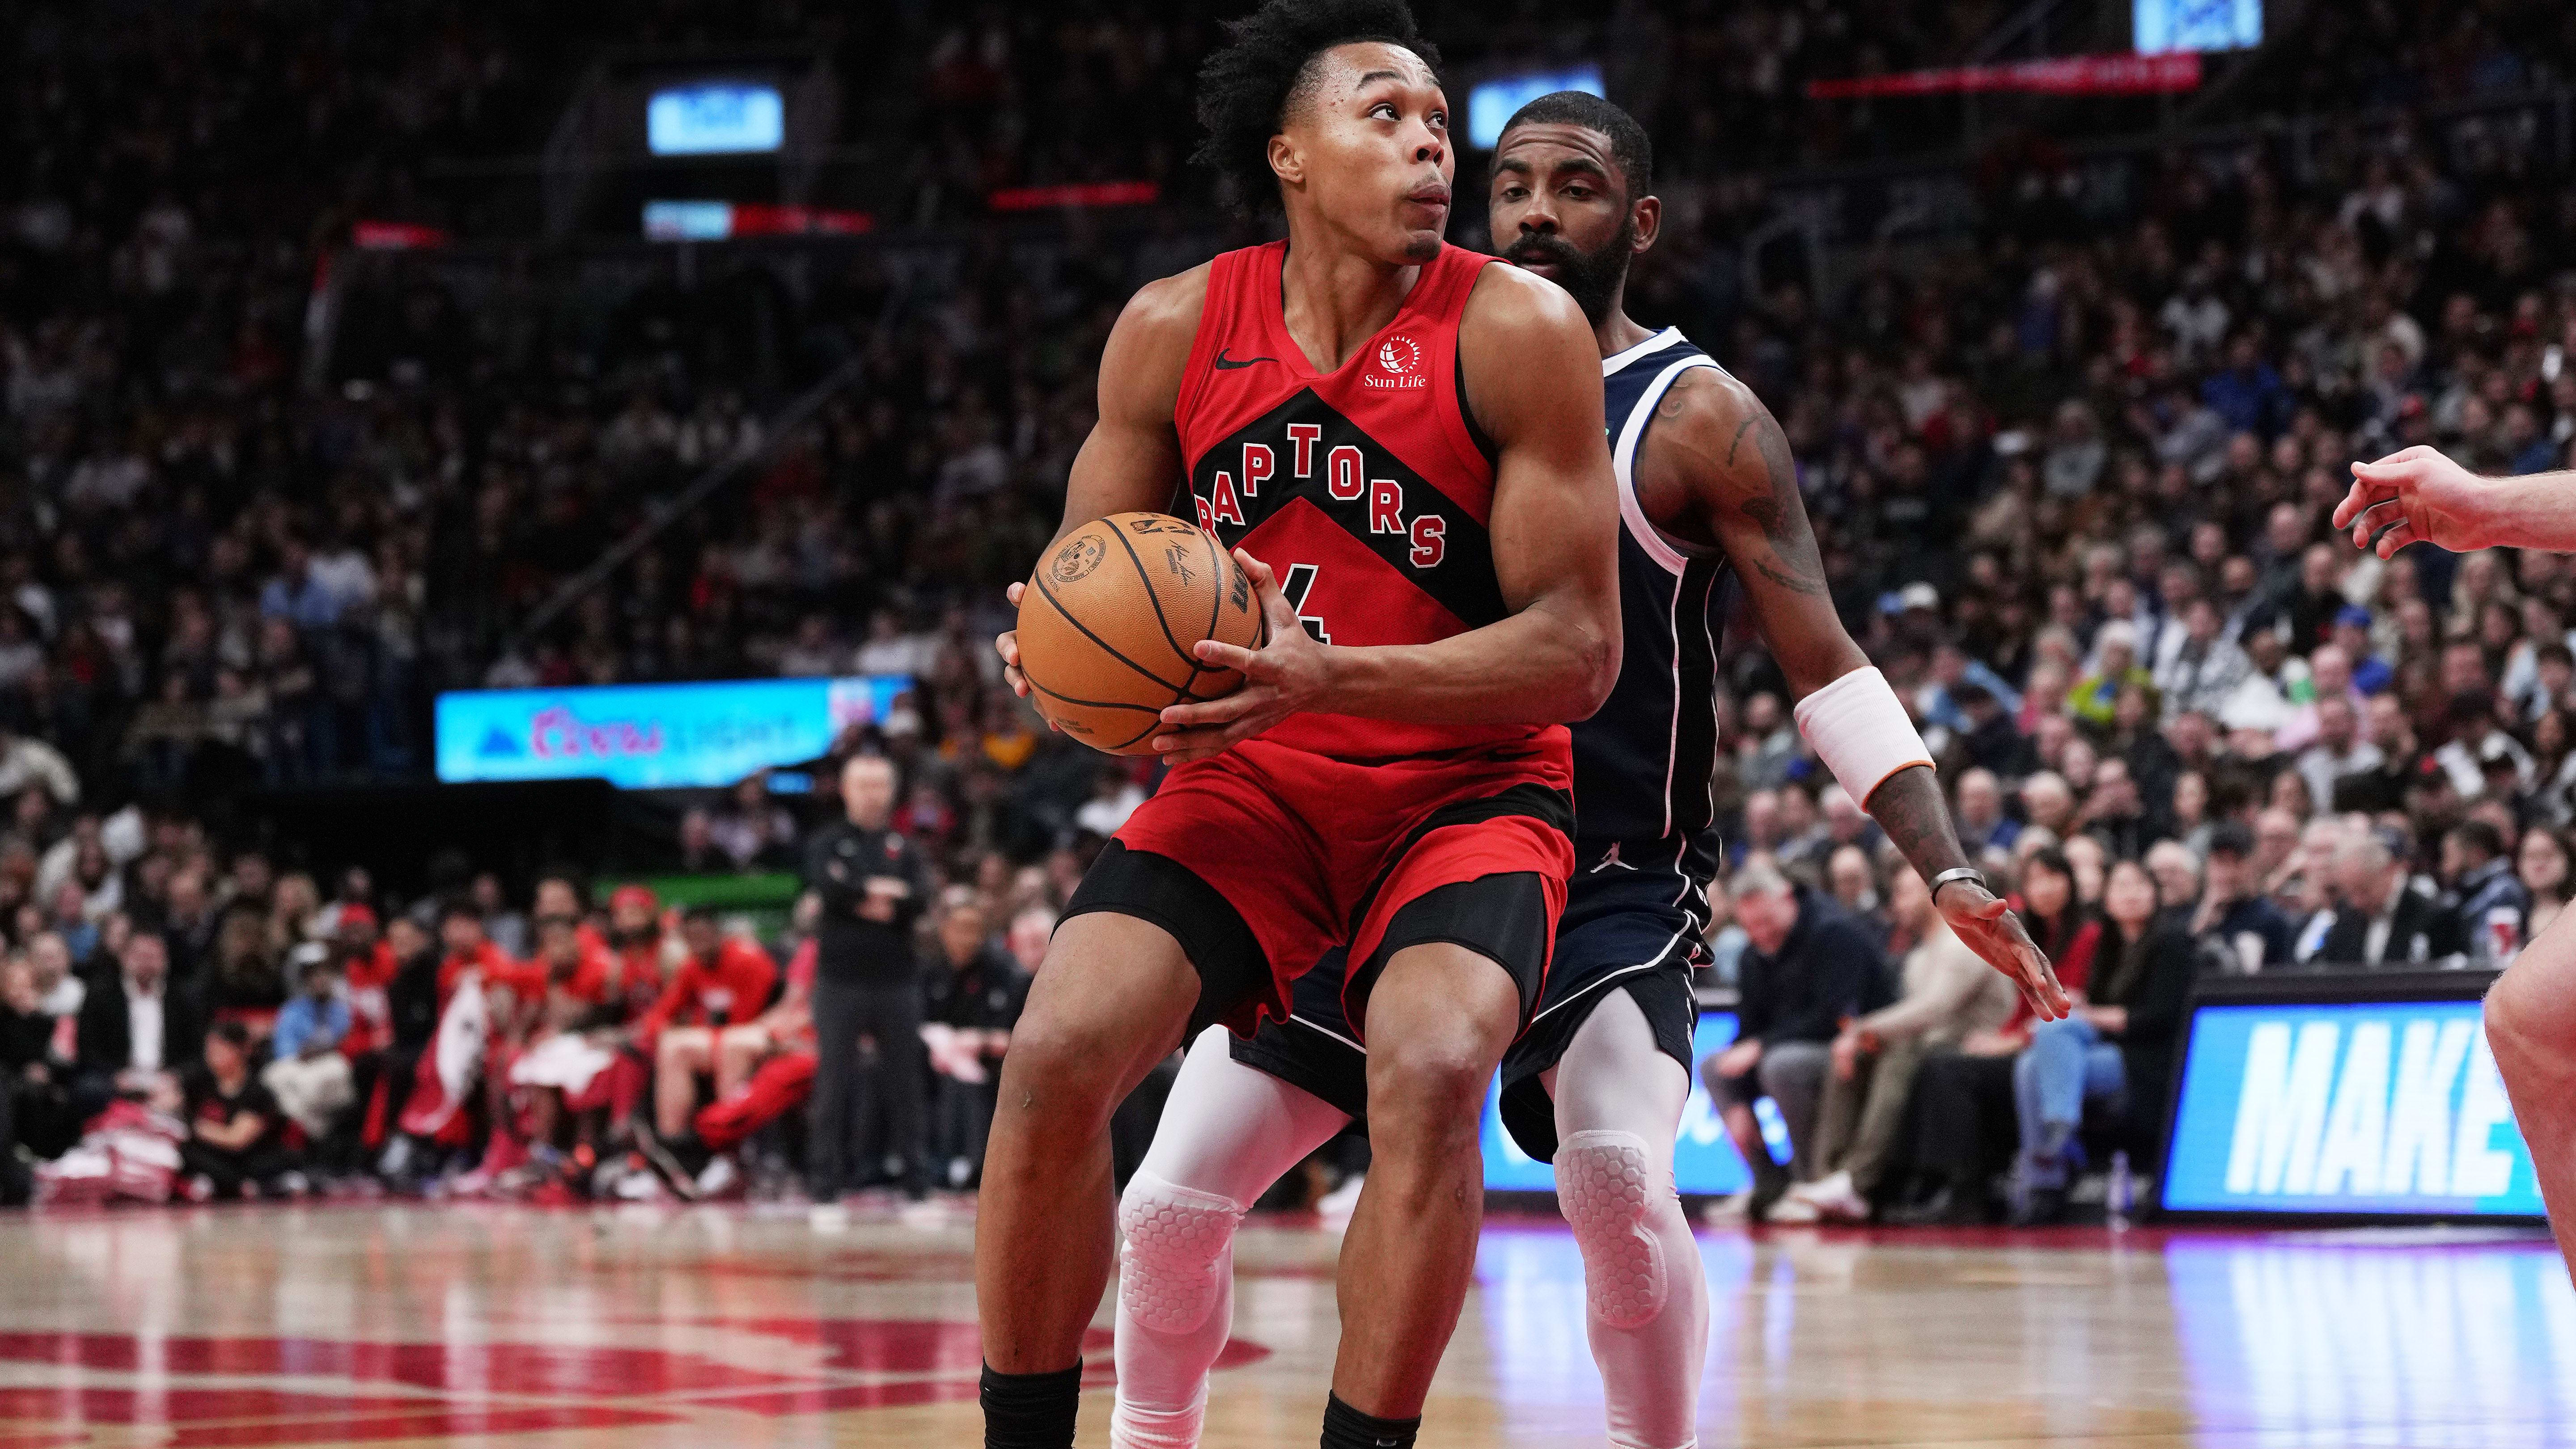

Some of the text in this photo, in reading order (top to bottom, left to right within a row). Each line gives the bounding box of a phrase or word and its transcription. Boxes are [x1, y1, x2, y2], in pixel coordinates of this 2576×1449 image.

[1364, 374, 1426, 388] Sun Life
[1193, 423, 1446, 568] RAPTORS
[2225, 1021, 2513, 1195] MAKE
